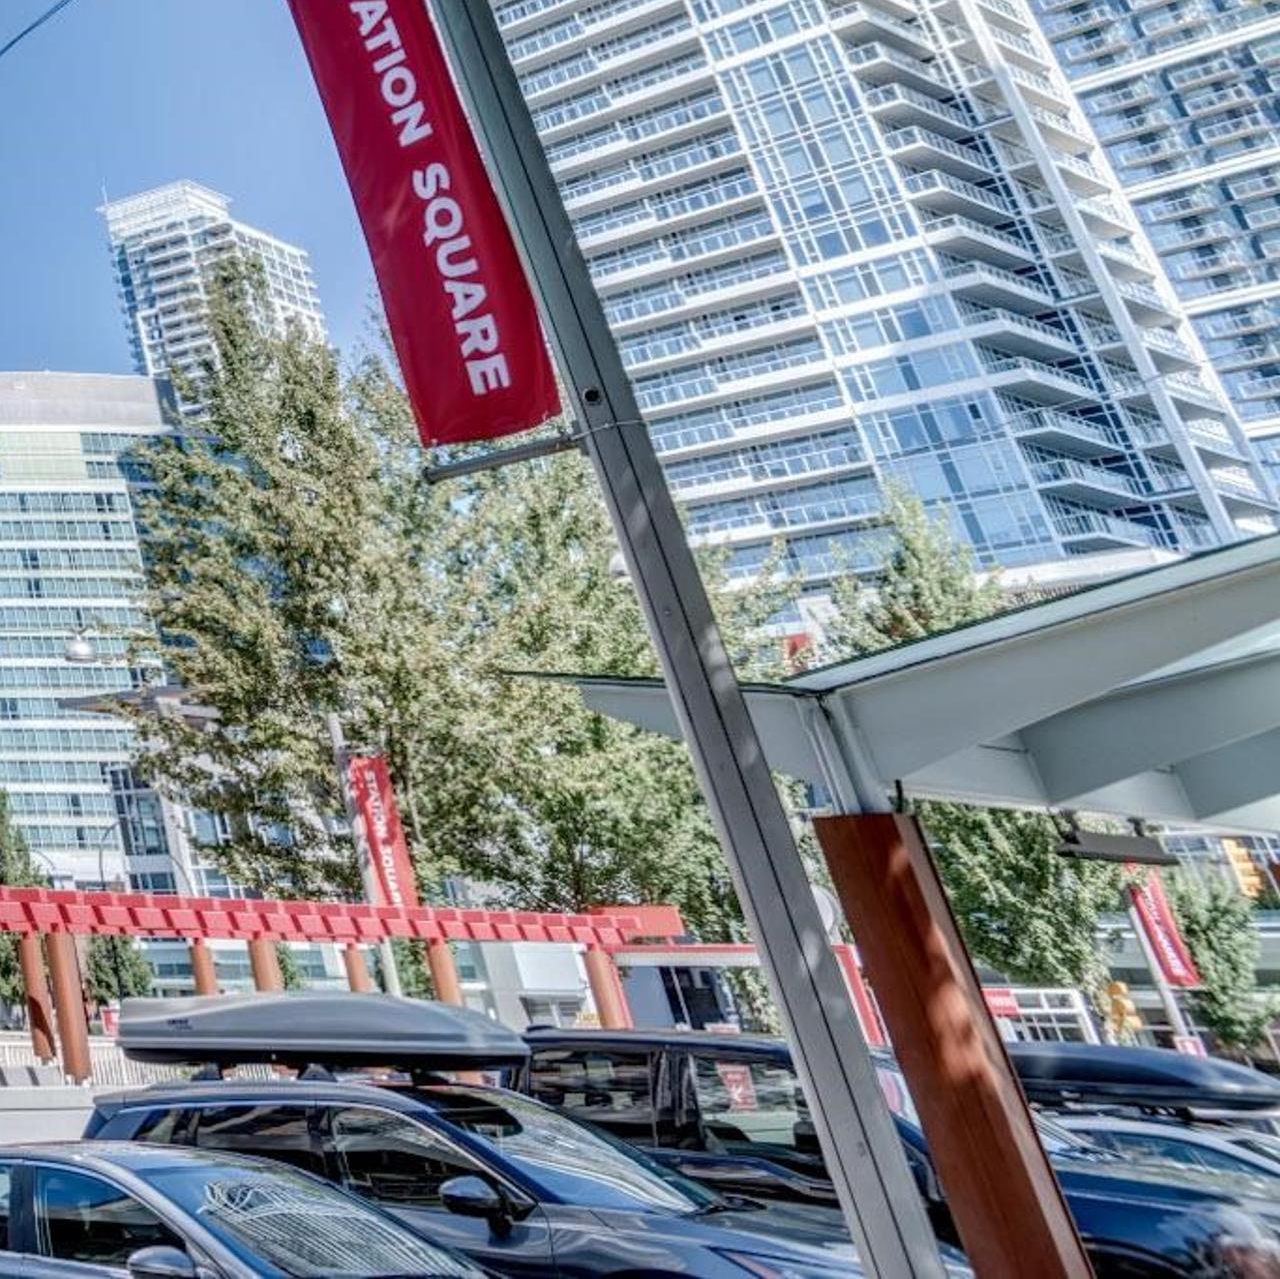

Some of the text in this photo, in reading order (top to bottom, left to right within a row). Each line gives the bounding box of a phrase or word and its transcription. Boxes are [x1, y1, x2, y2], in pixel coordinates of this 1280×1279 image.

[413, 163, 511, 396] SQUARE
[364, 771, 403, 904] STATION SQUAR
